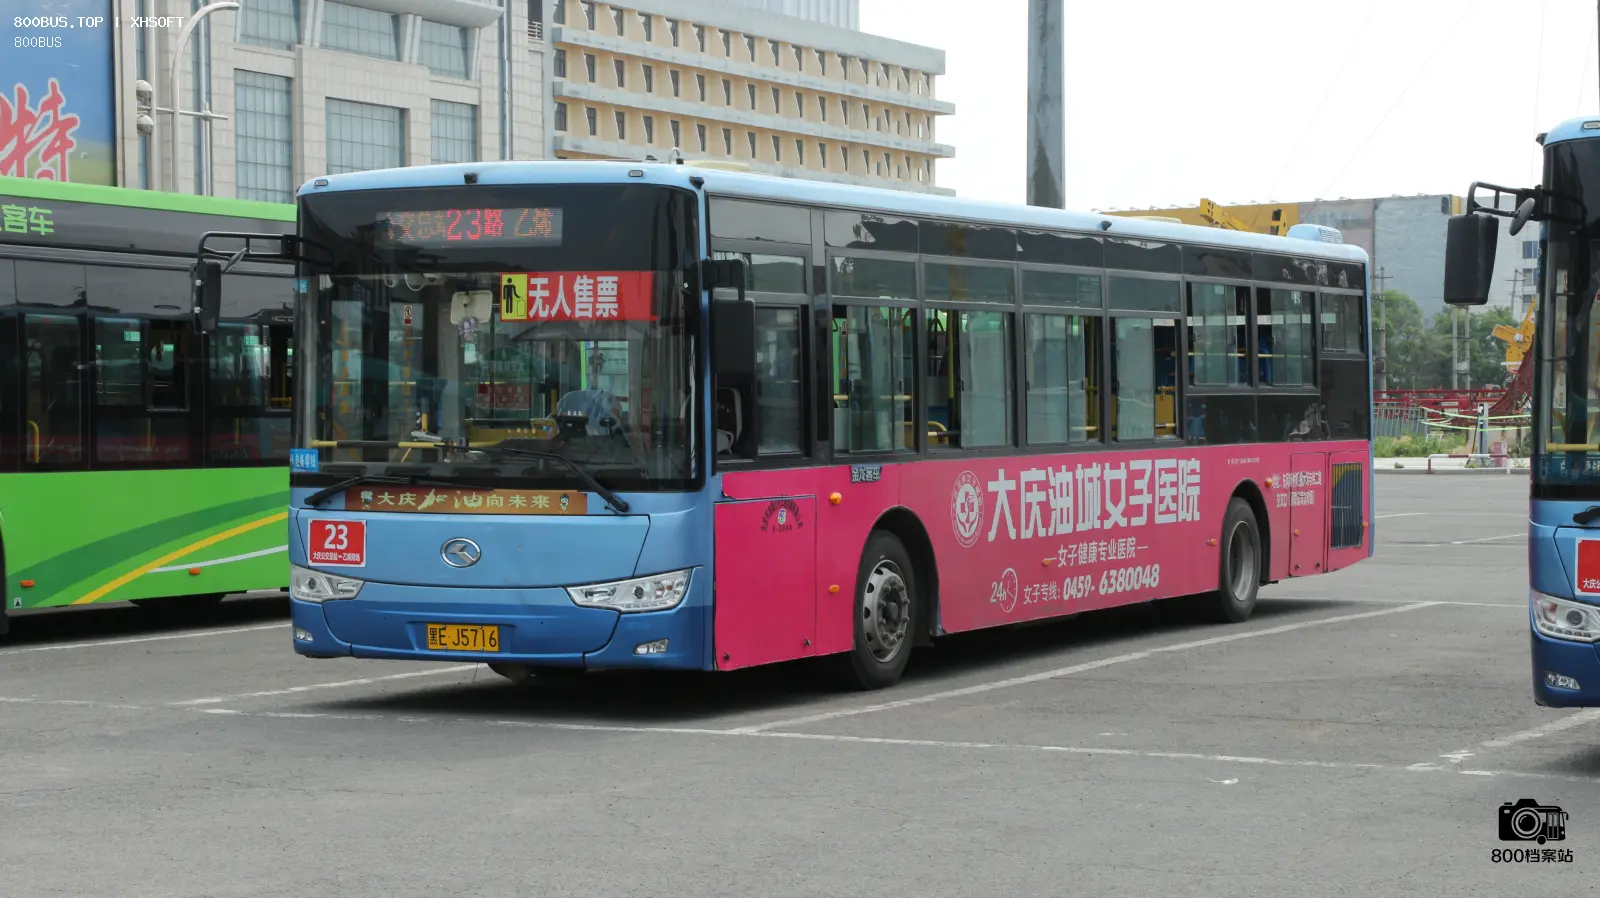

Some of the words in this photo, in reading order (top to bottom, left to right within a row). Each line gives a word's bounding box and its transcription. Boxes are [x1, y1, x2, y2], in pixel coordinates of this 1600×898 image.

[447, 208, 505, 241] 23路
[528, 275, 619, 318] 无人售票
[377, 488, 551, 511] 大庆加油向未来
[987, 457, 1202, 542] 大庆油城女子医院
[324, 524, 348, 550] 23
[1057, 536, 1136, 568] 女子健康专业医院
